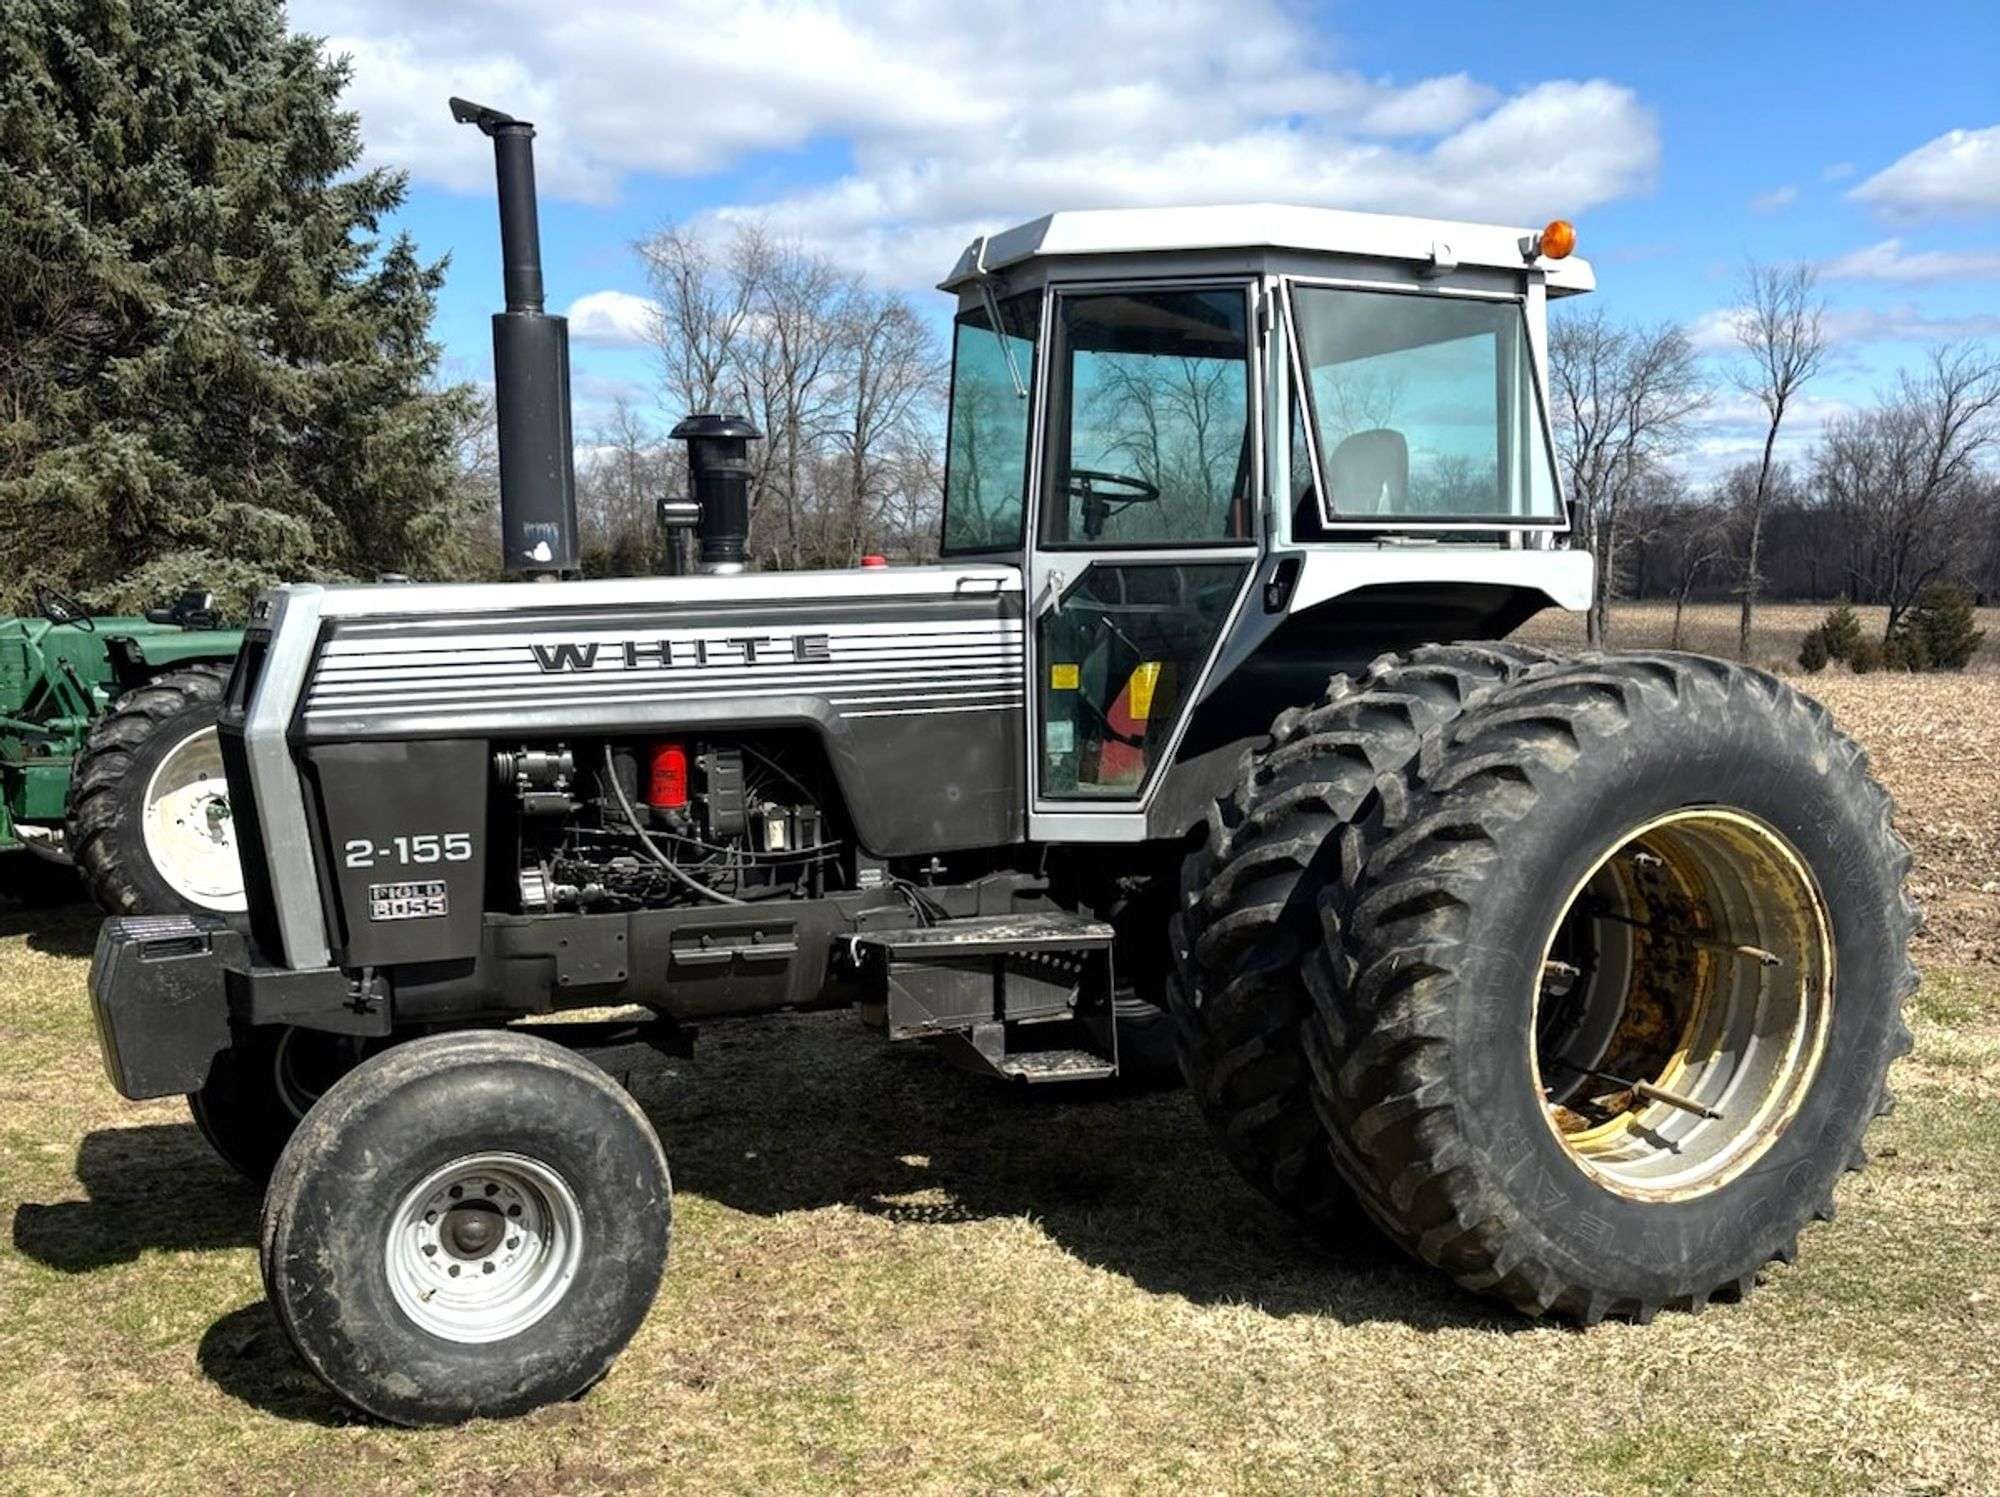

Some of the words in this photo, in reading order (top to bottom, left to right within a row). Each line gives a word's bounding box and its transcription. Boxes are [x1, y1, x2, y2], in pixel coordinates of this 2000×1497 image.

[530, 633, 831, 673] WHITE
[345, 832, 472, 868] 2-155
[373, 899, 445, 917] BOSS
